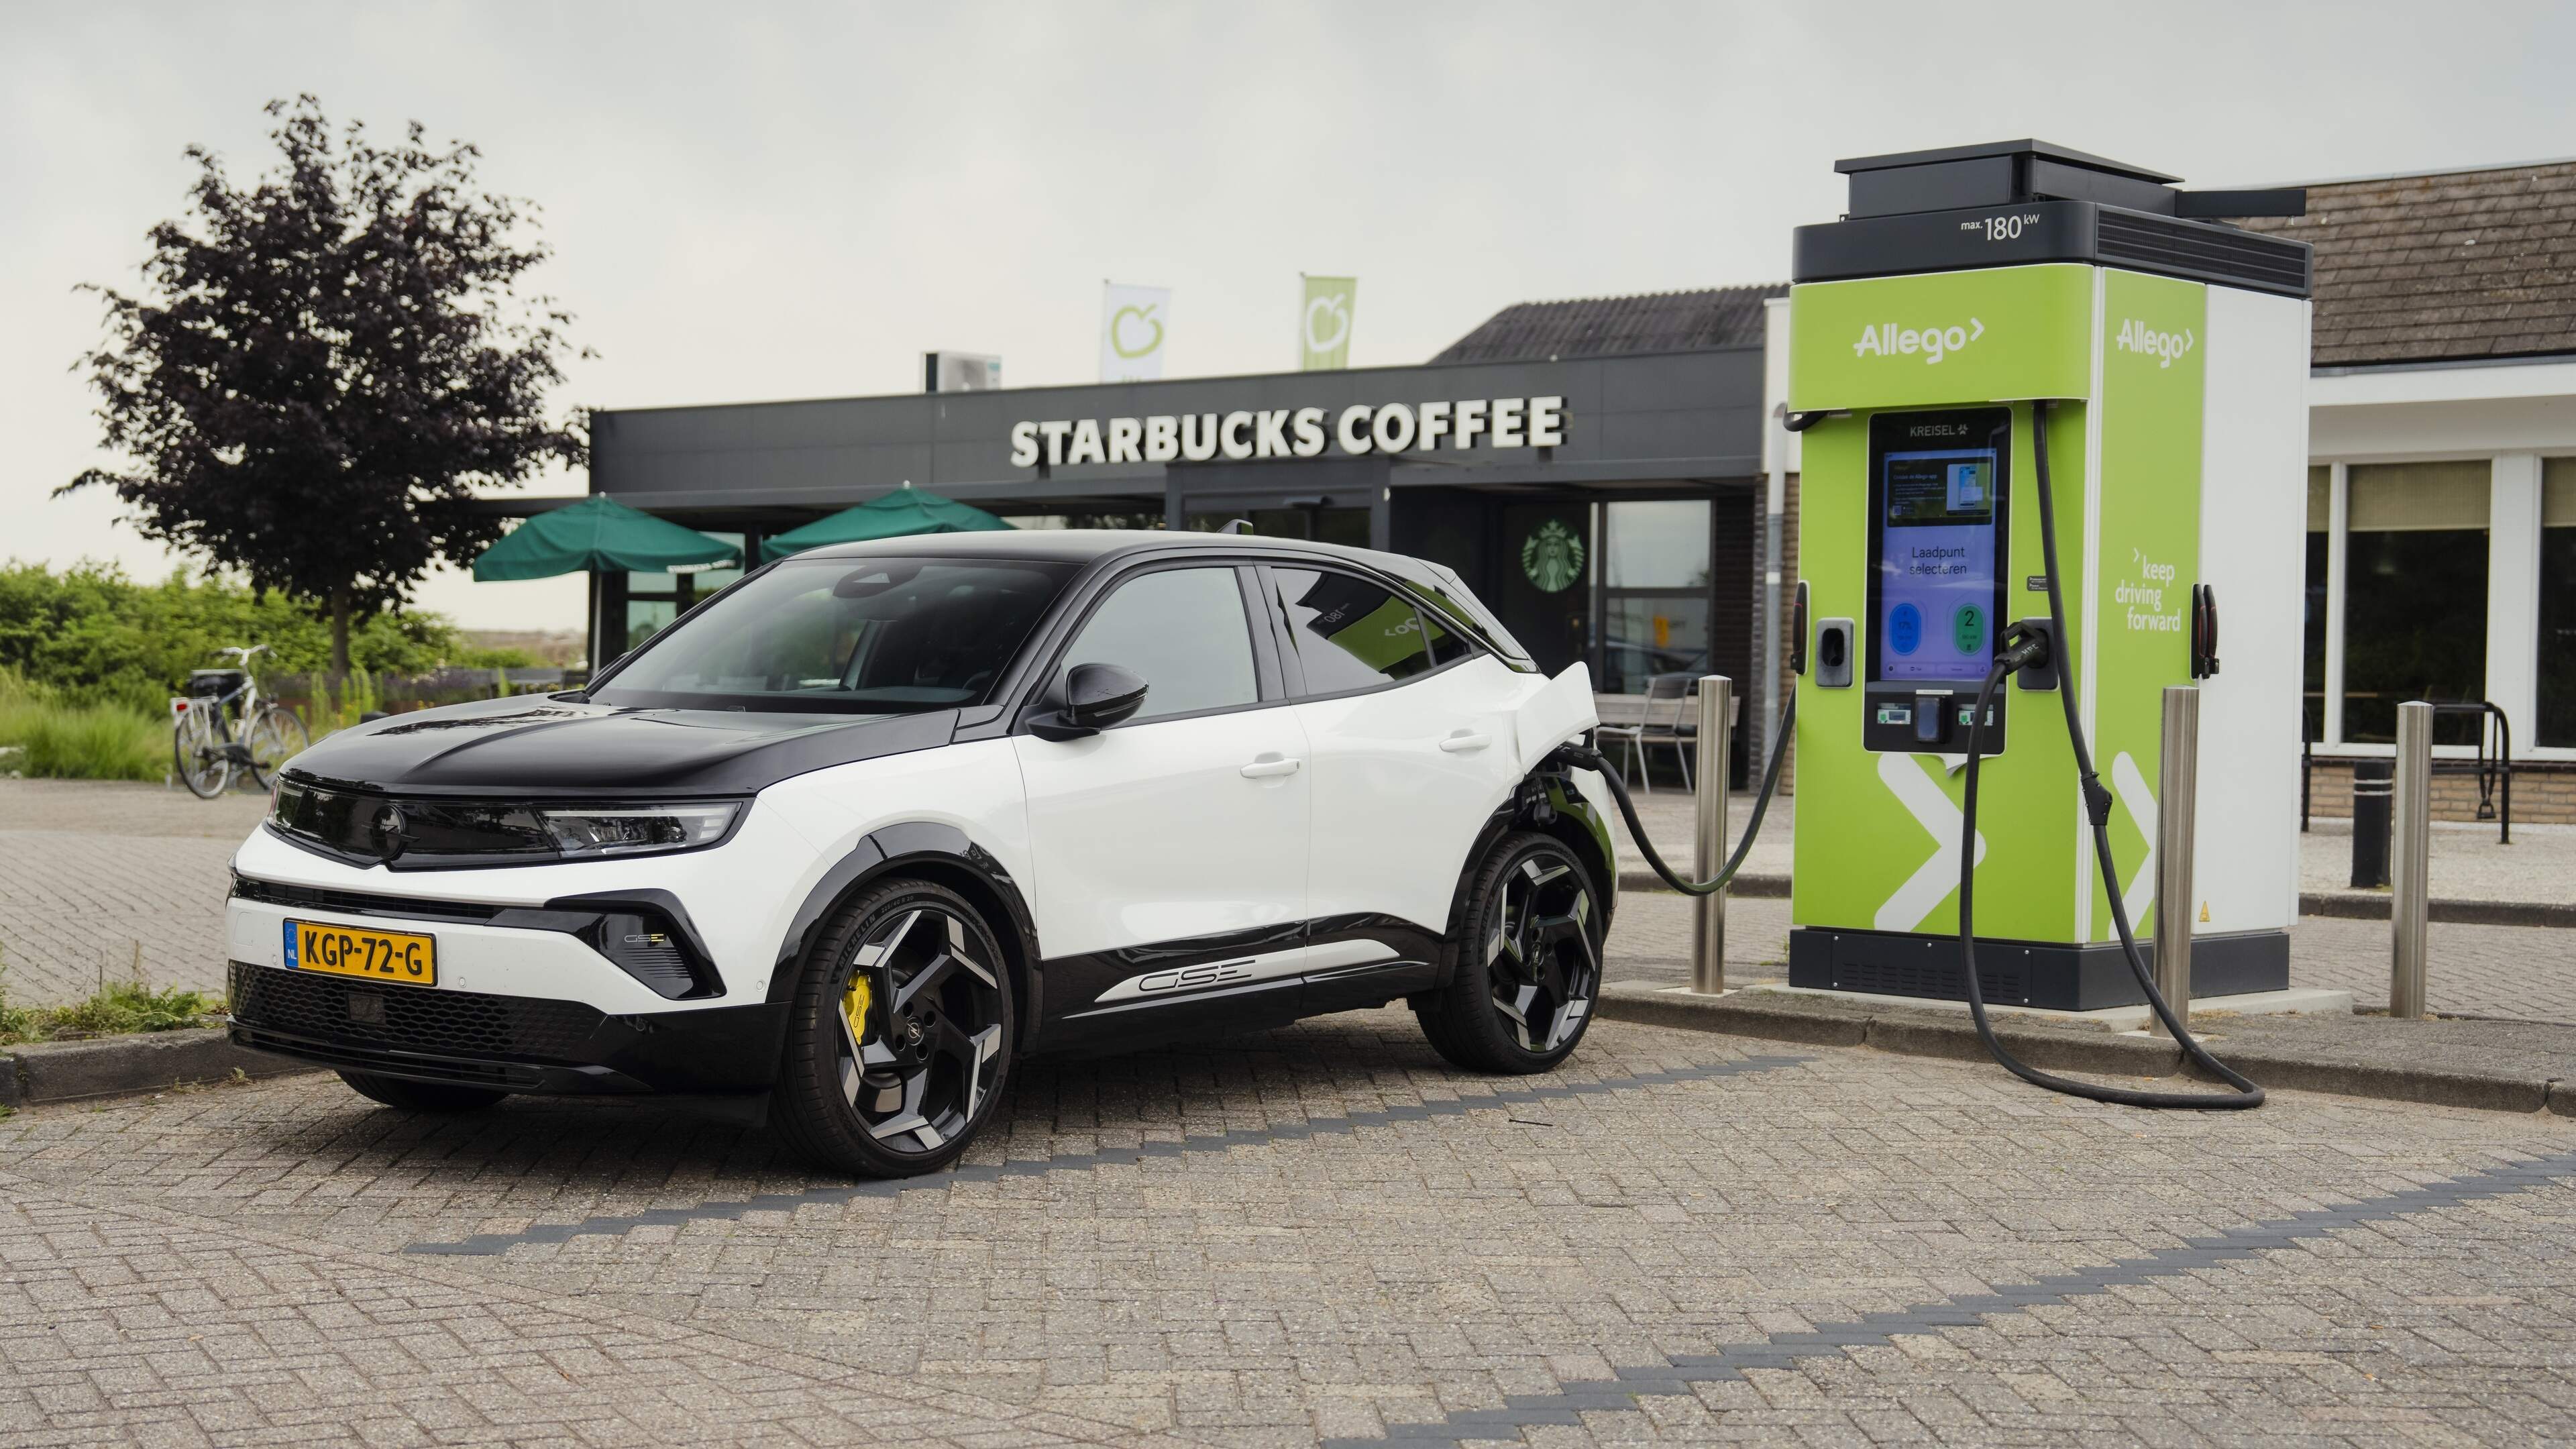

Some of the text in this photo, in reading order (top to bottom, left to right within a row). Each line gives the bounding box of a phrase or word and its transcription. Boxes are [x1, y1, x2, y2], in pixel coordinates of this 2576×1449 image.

[1961, 214, 2040, 240] max. 180 kW
[1854, 322, 1966, 364] Allego
[2116, 319, 2184, 368] Allego
[1010, 396, 1564, 468] STARBUCKS COFFEE
[1910, 425, 1955, 437] KREISEL
[1912, 546, 1965, 559] Laadpunt
[1909, 562, 1967, 576] selecteren
[2143, 555, 2175, 587] keep
[2115, 579, 2162, 612] driving
[1964, 610, 1974, 627] 2
[2127, 606, 2181, 632] forward
[305, 930, 423, 976] KGP-72-G
[624, 934, 664, 943] GSE
[838, 914, 876, 969] MICHELIN
[288, 949, 297, 960] NL
[1138, 959, 1256, 992] GSE
